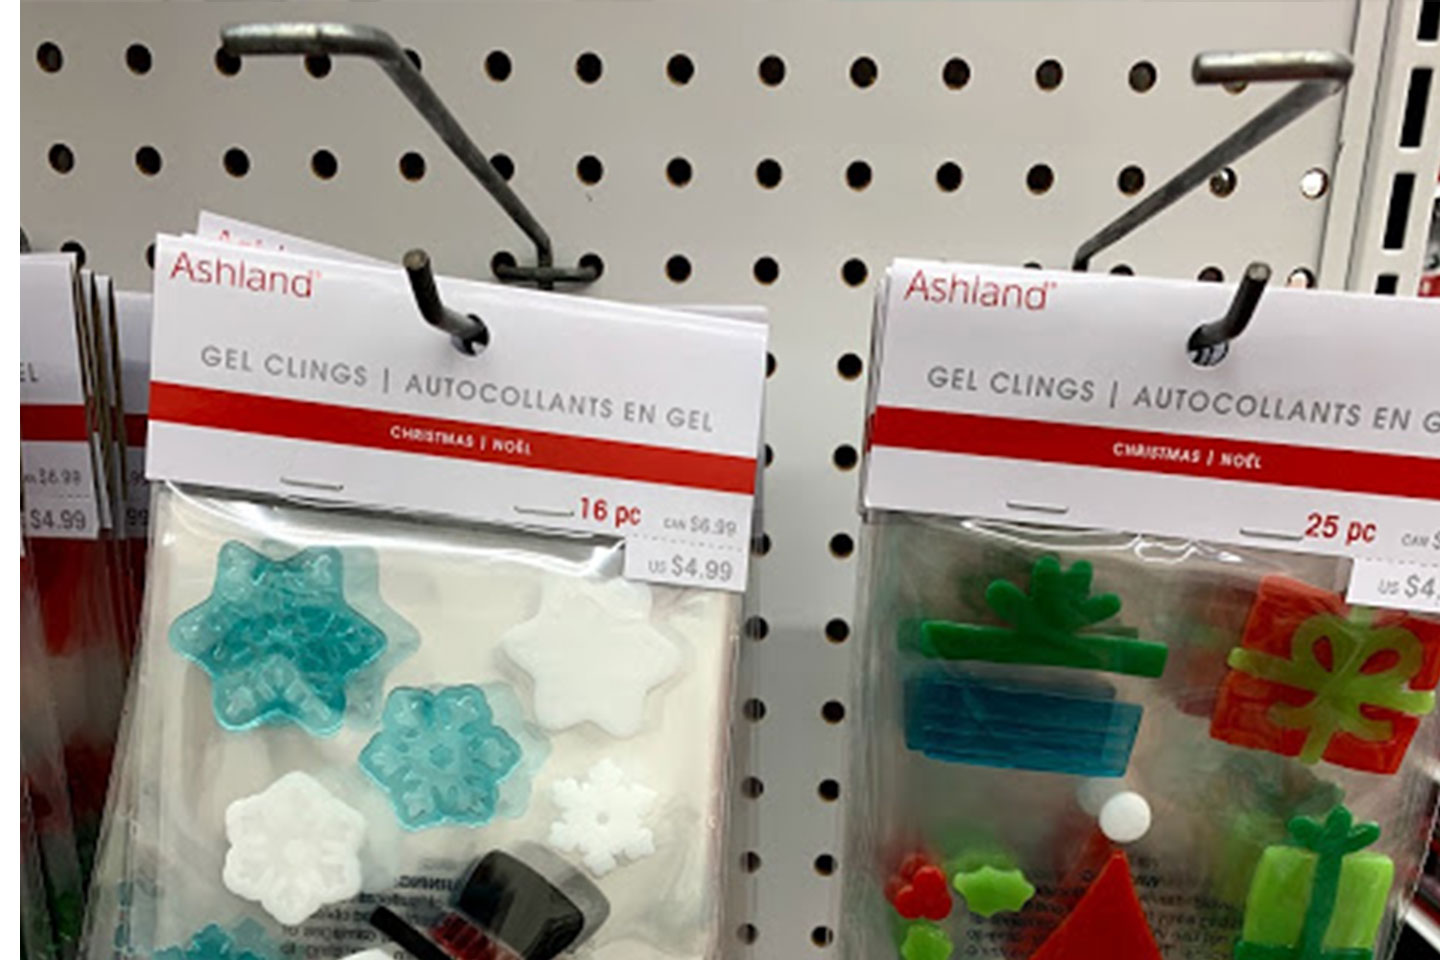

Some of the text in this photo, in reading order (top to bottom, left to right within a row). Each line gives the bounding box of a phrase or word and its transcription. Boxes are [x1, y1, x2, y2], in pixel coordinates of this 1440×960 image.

[170, 251, 313, 299] Ashland
[904, 268, 1050, 311] Ashland
[201, 345, 252, 372] GEL
[264, 353, 367, 386] CLINGS
[405, 374, 612, 419] AUTOCOLLANTS
[623, 402, 656, 424] EN
[666, 407, 713, 432] GEL
[927, 365, 977, 391] GEL
[990, 371, 1095, 402] CLINGS
[1133, 386, 1362, 427] AUTOCOLLANTS
[1373, 406, 1410, 431] EN
[389, 425, 474, 448] CHRISTMAS
[1113, 442, 1201, 464] CHRISTMAS
[30, 508, 86, 531] $4.99
[581, 497, 641, 529] 16 pc
[664, 515, 737, 537] CAN $6.99
[1305, 511, 1377, 547] 25 pc
[649, 554, 732, 582] US $4.99
